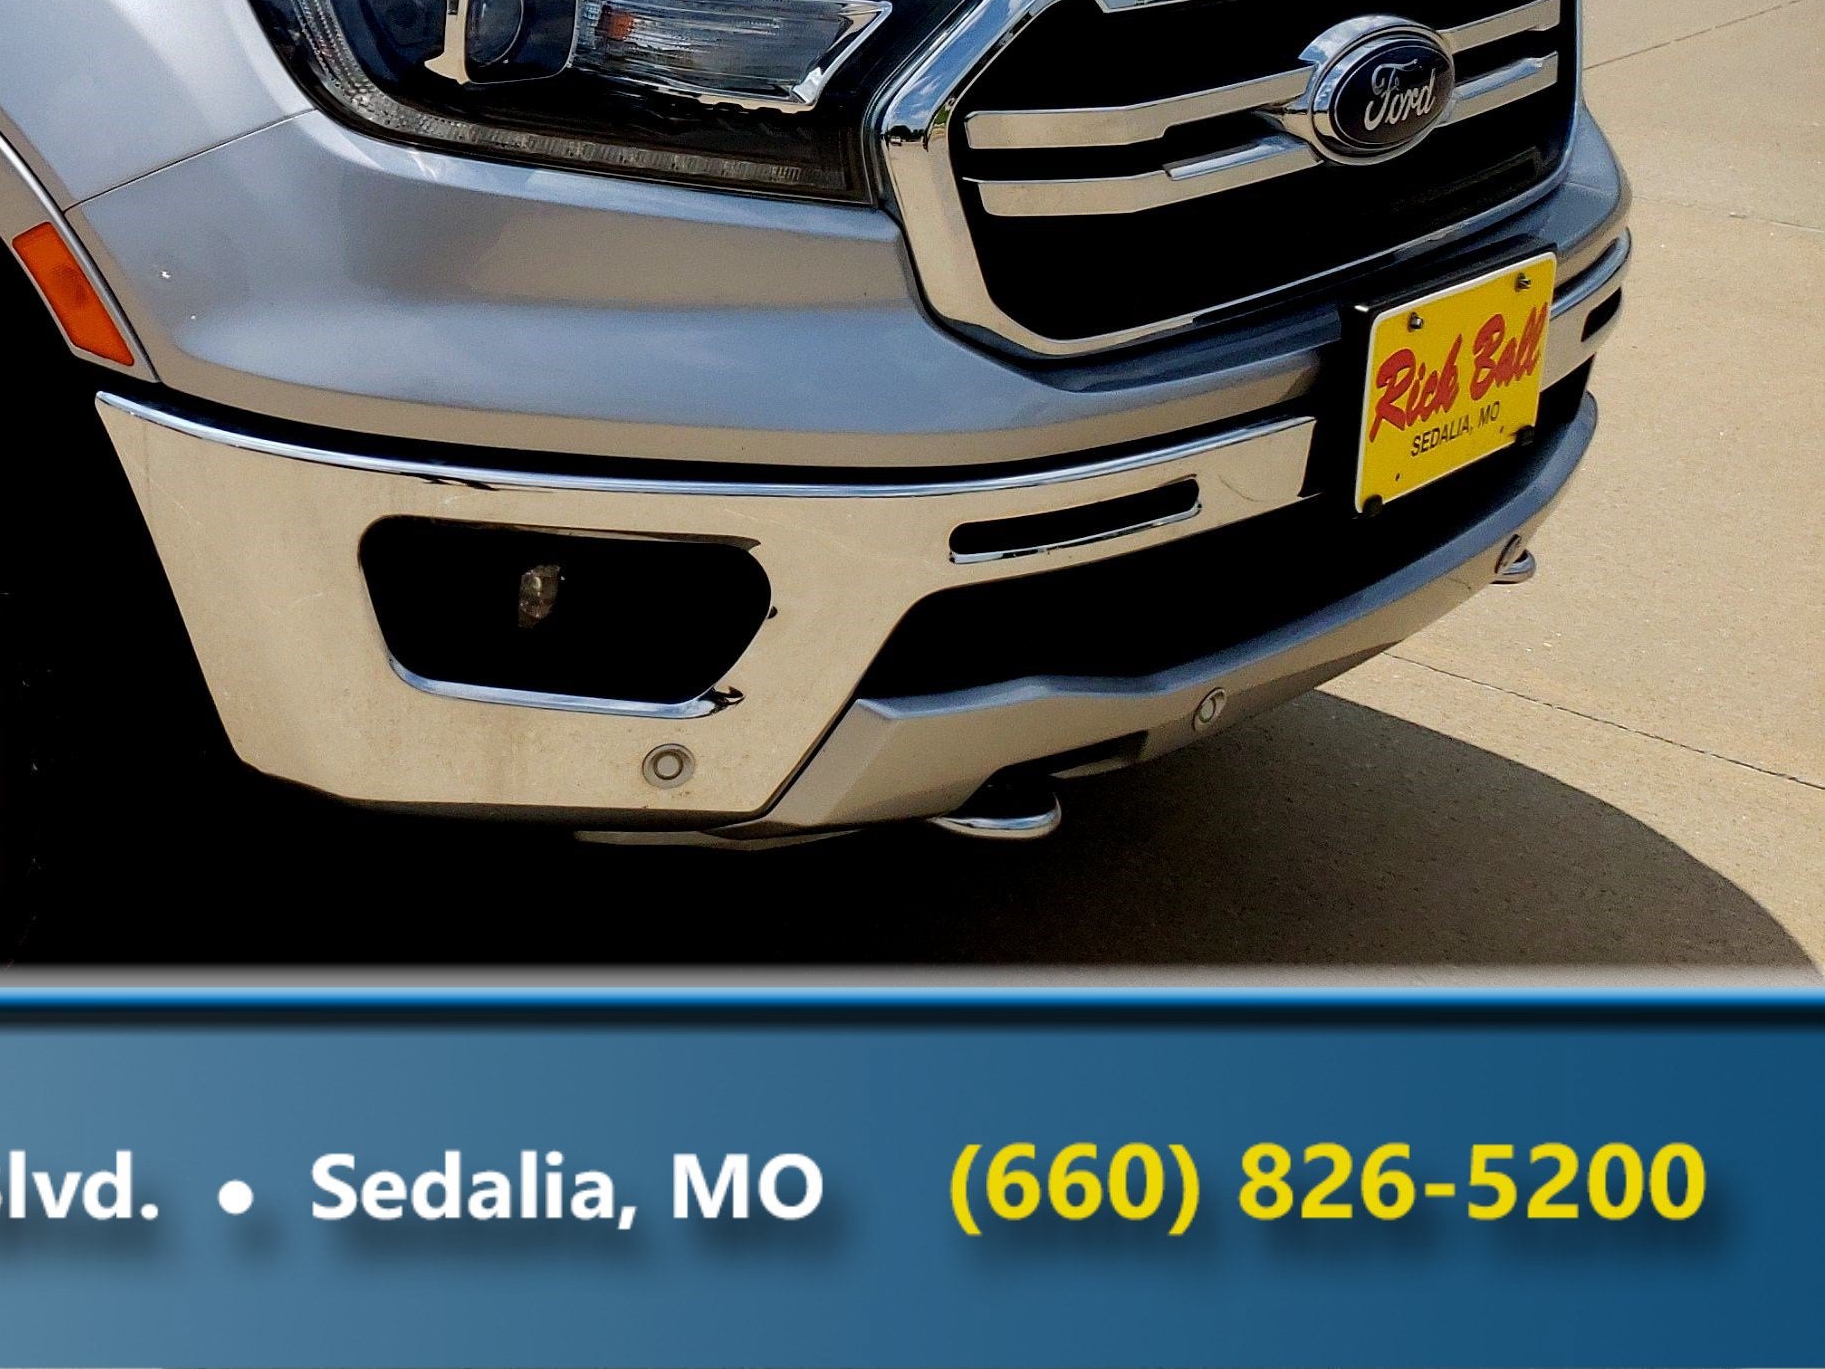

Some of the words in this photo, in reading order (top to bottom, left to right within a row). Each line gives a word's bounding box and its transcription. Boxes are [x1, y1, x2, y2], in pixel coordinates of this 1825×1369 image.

[1364, 58, 1436, 131] Ford
[1369, 333, 1463, 443] Rick
[1470, 301, 1549, 401] Ball
[1411, 414, 1473, 457] SEDALIA,
[1477, 400, 1500, 429] MO
